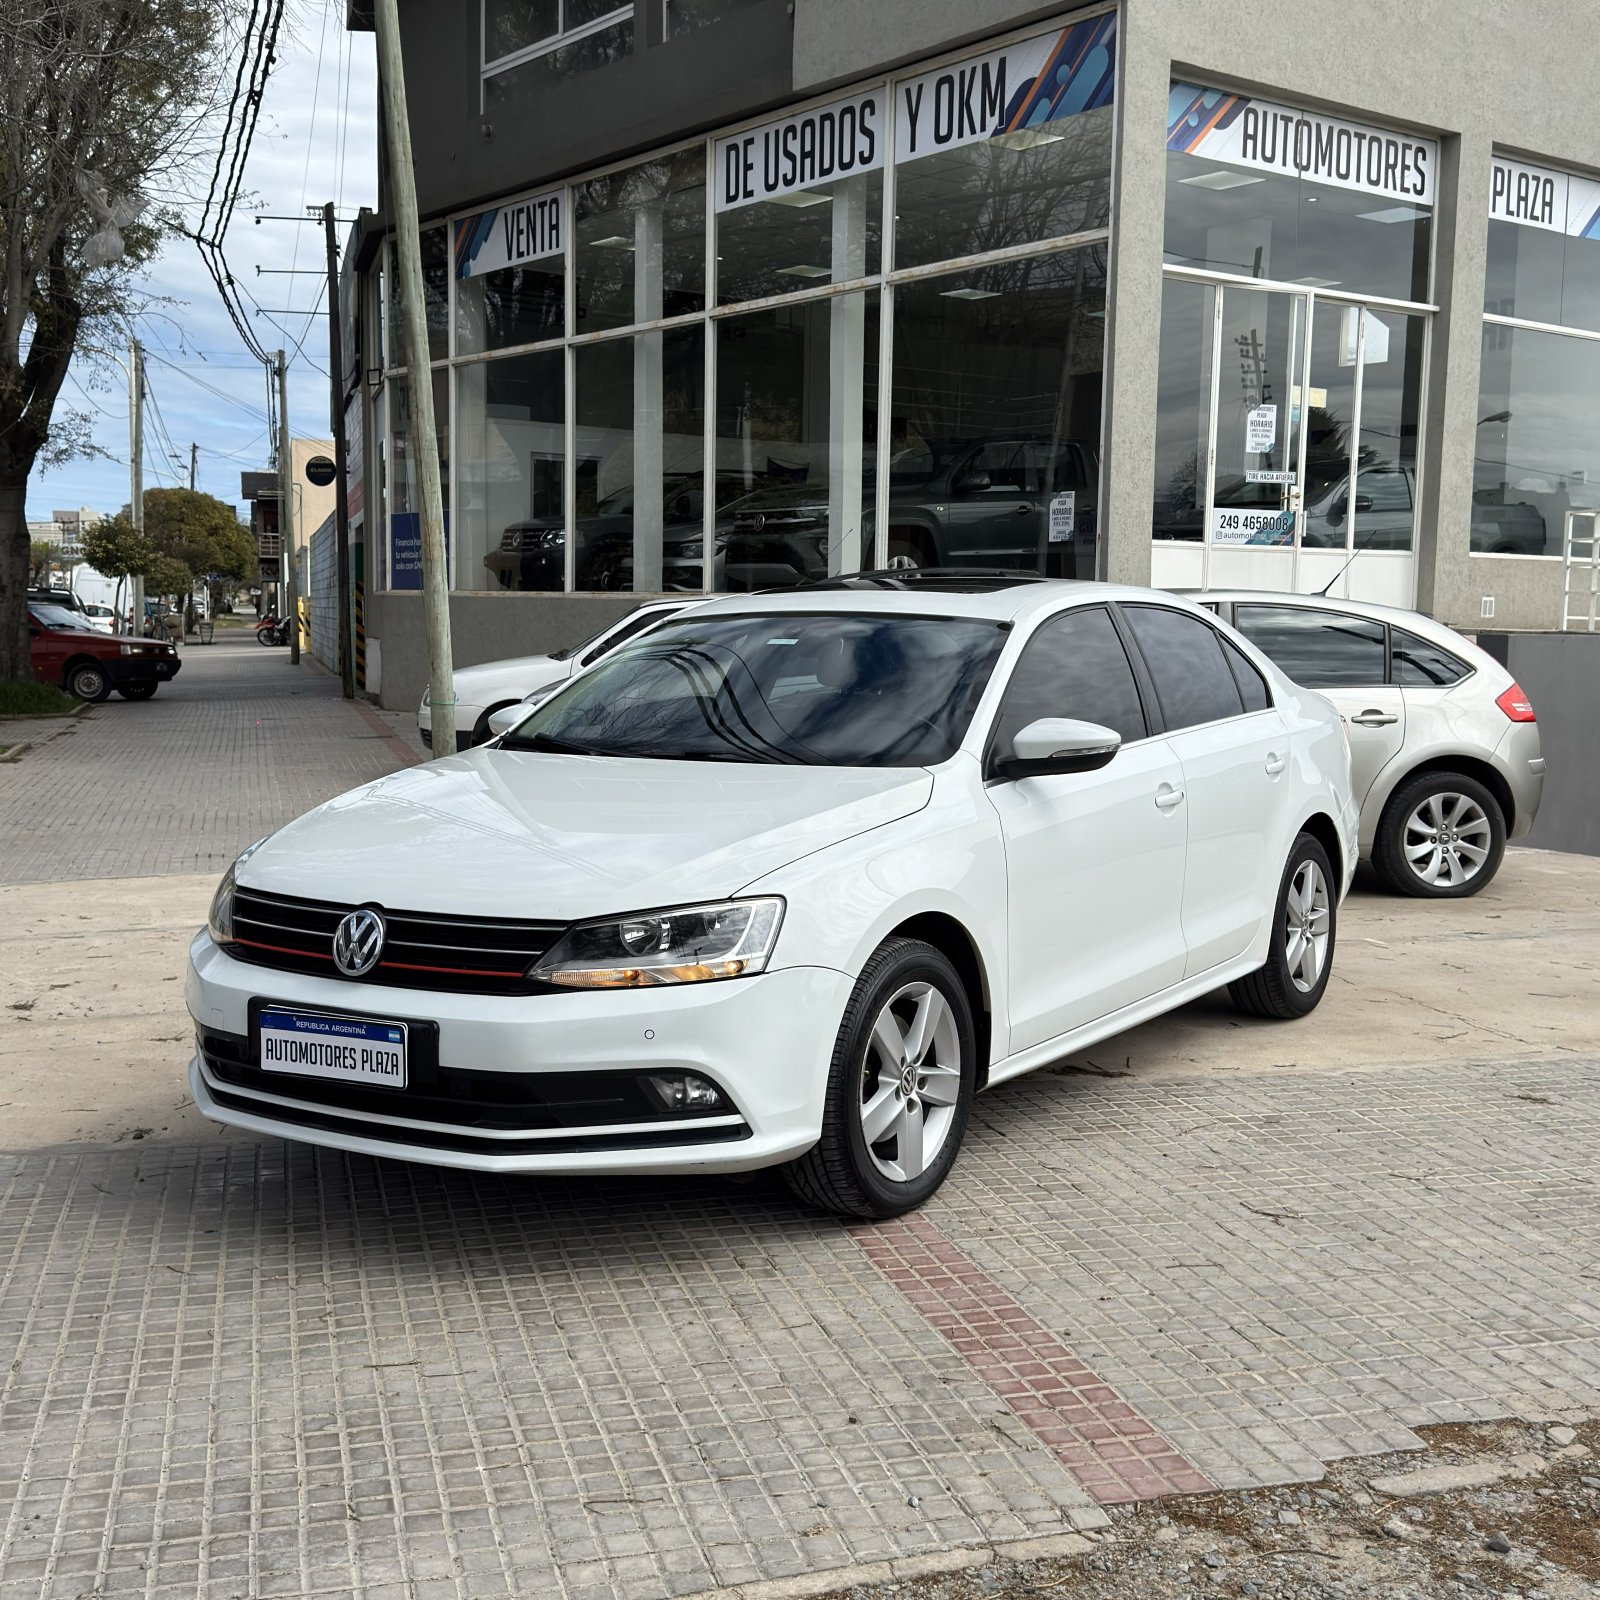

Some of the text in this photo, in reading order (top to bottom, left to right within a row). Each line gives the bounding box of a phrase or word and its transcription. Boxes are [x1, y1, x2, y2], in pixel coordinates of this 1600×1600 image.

[725, 137, 755, 204] DE
[764, 99, 876, 193] USADOS
[905, 83, 924, 153] Y
[1242, 106, 1554, 225] AUTOMOTORES PLAZA
[504, 197, 560, 261] VENTA
[1249, 419, 1273, 429] HORARIO
[1248, 472, 1259, 480] TIRE
[1260, 473, 1275, 481] HACIA
[1220, 514, 1289, 531] 249 4658008
[296, 1020, 366, 1035] REPUBLICA ARGENTINA
[265, 1037, 399, 1076] AUTOMOTORES PLAZA
